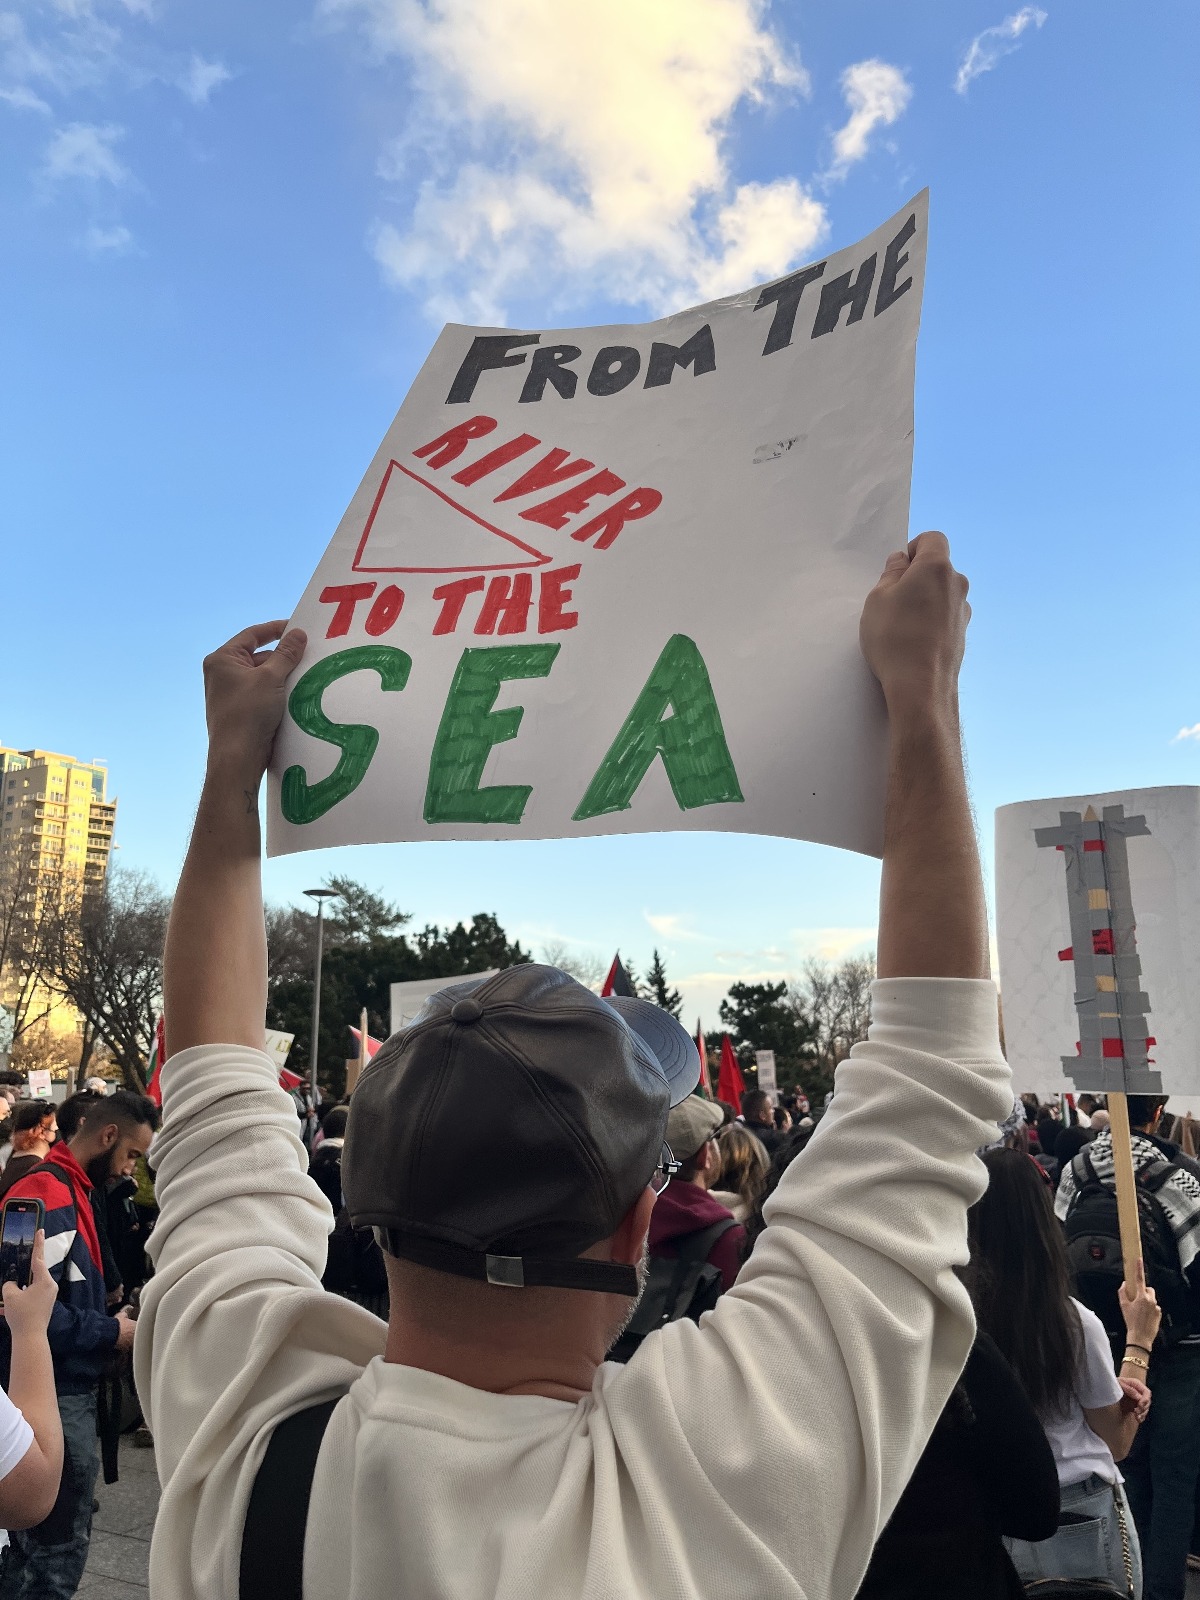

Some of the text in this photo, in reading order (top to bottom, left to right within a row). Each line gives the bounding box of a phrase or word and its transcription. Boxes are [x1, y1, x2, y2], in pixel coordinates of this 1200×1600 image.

[445, 213, 916, 404] FROM THE
[412, 415, 663, 549] RIVER
[318, 563, 582, 639] TO THE
[281, 633, 745, 824] SEA
